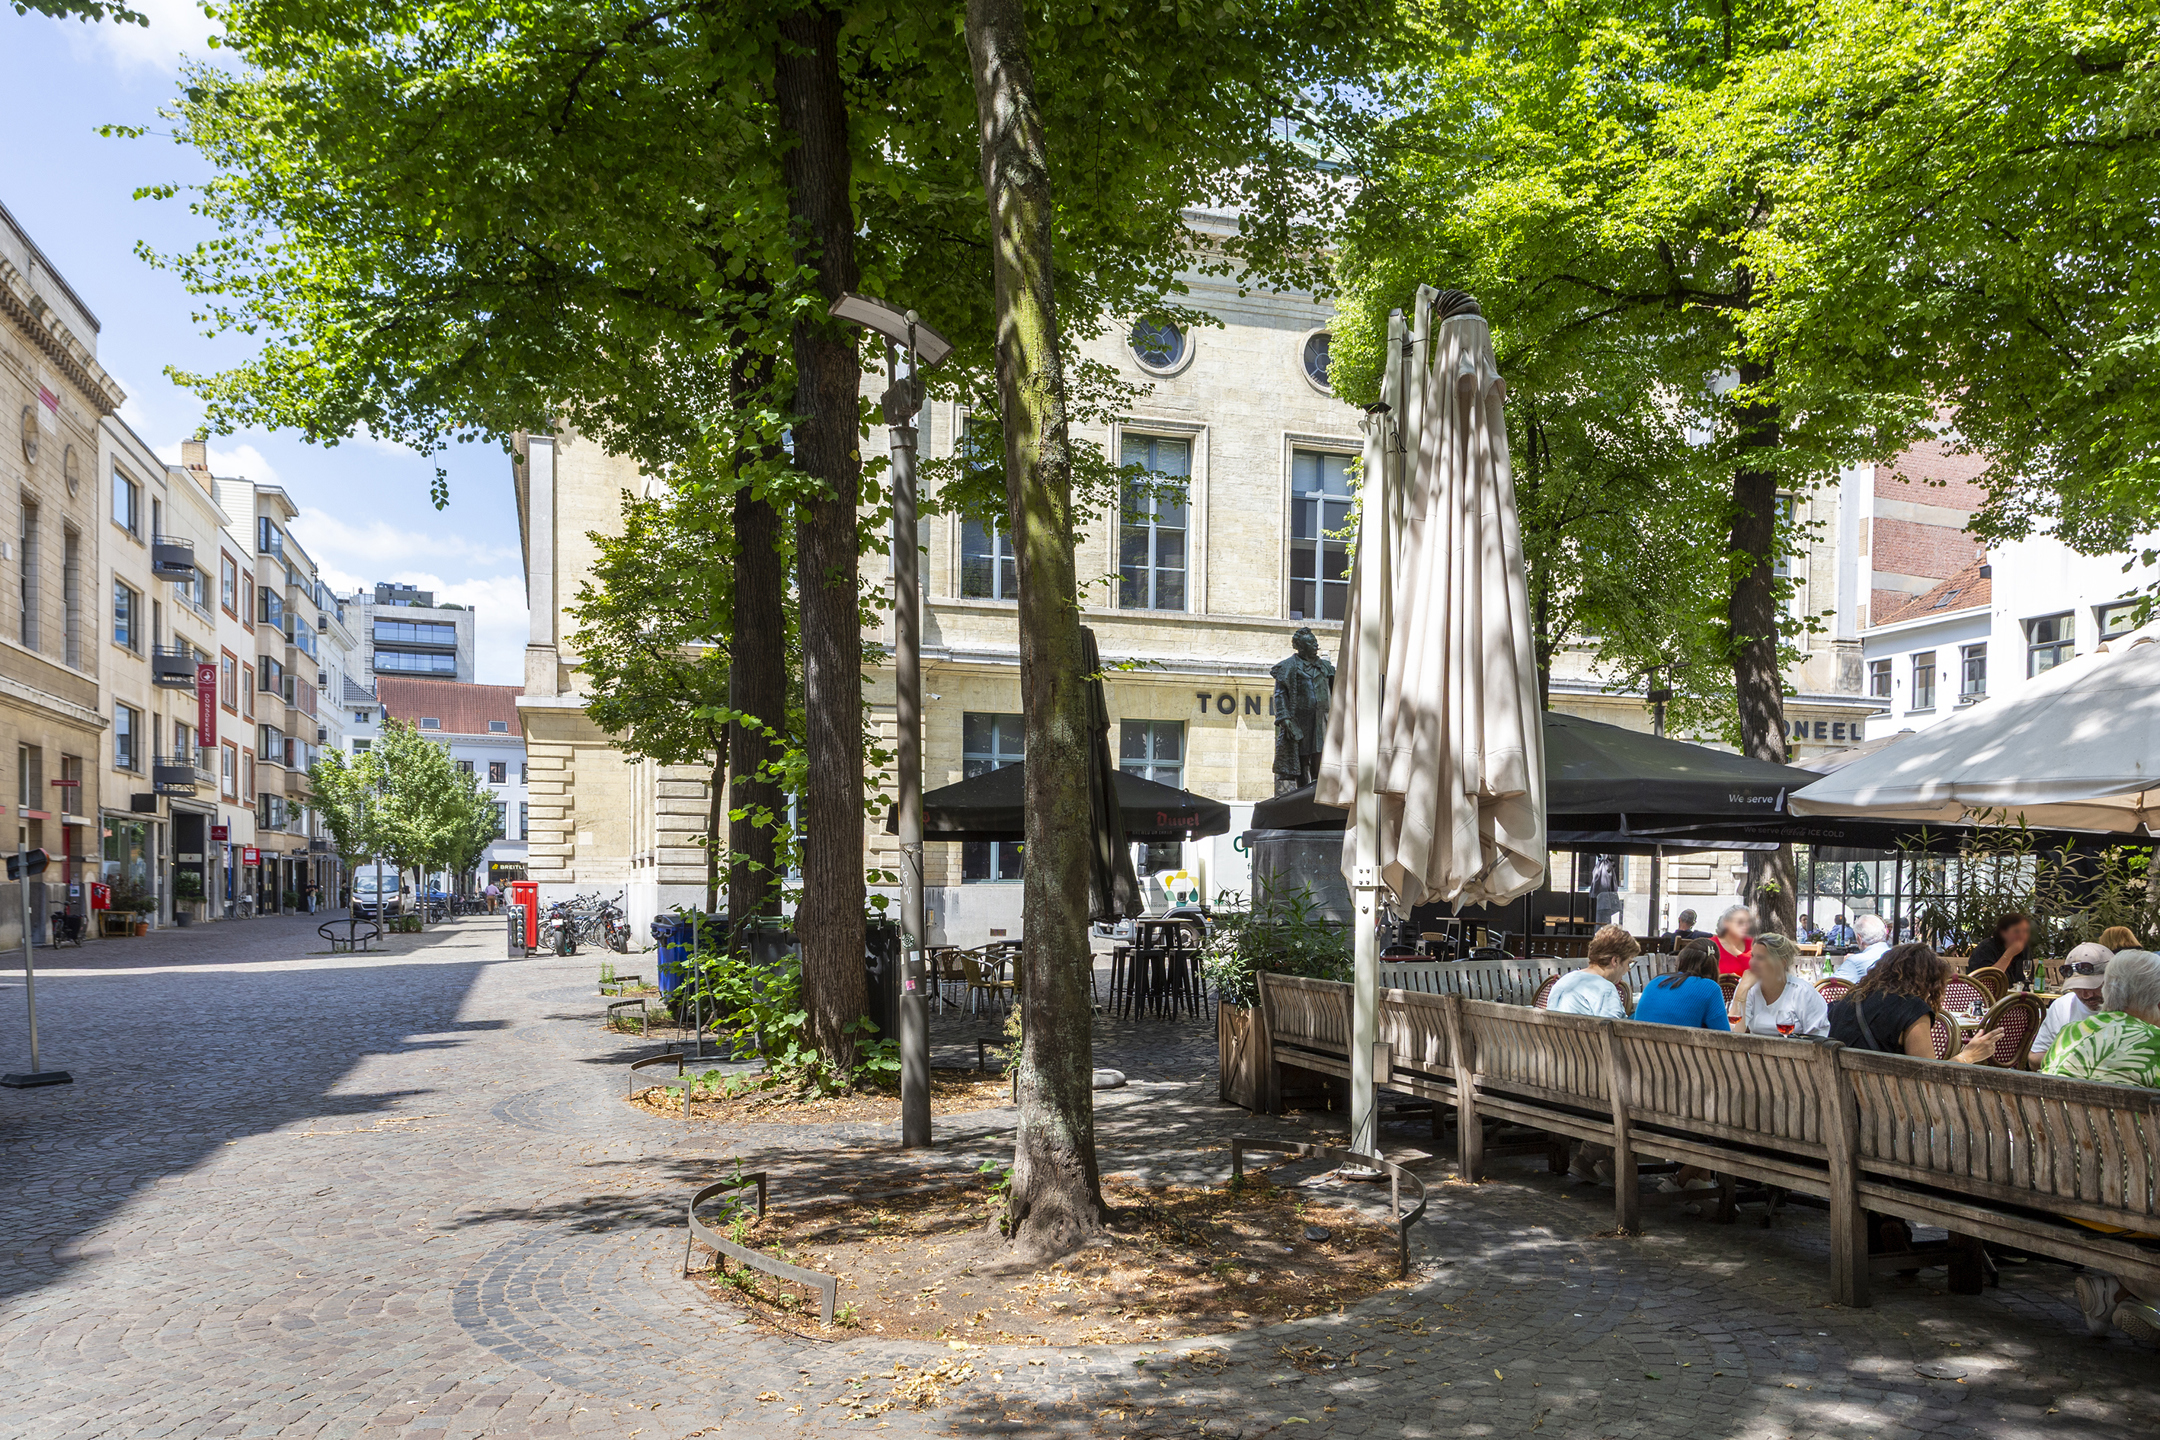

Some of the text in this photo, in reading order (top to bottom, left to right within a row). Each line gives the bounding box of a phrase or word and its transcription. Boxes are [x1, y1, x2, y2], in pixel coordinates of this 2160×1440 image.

[1728, 794, 1774, 804] We serve
[1156, 811, 1200, 827] Duvel
[1822, 829, 1845, 838] COLD
